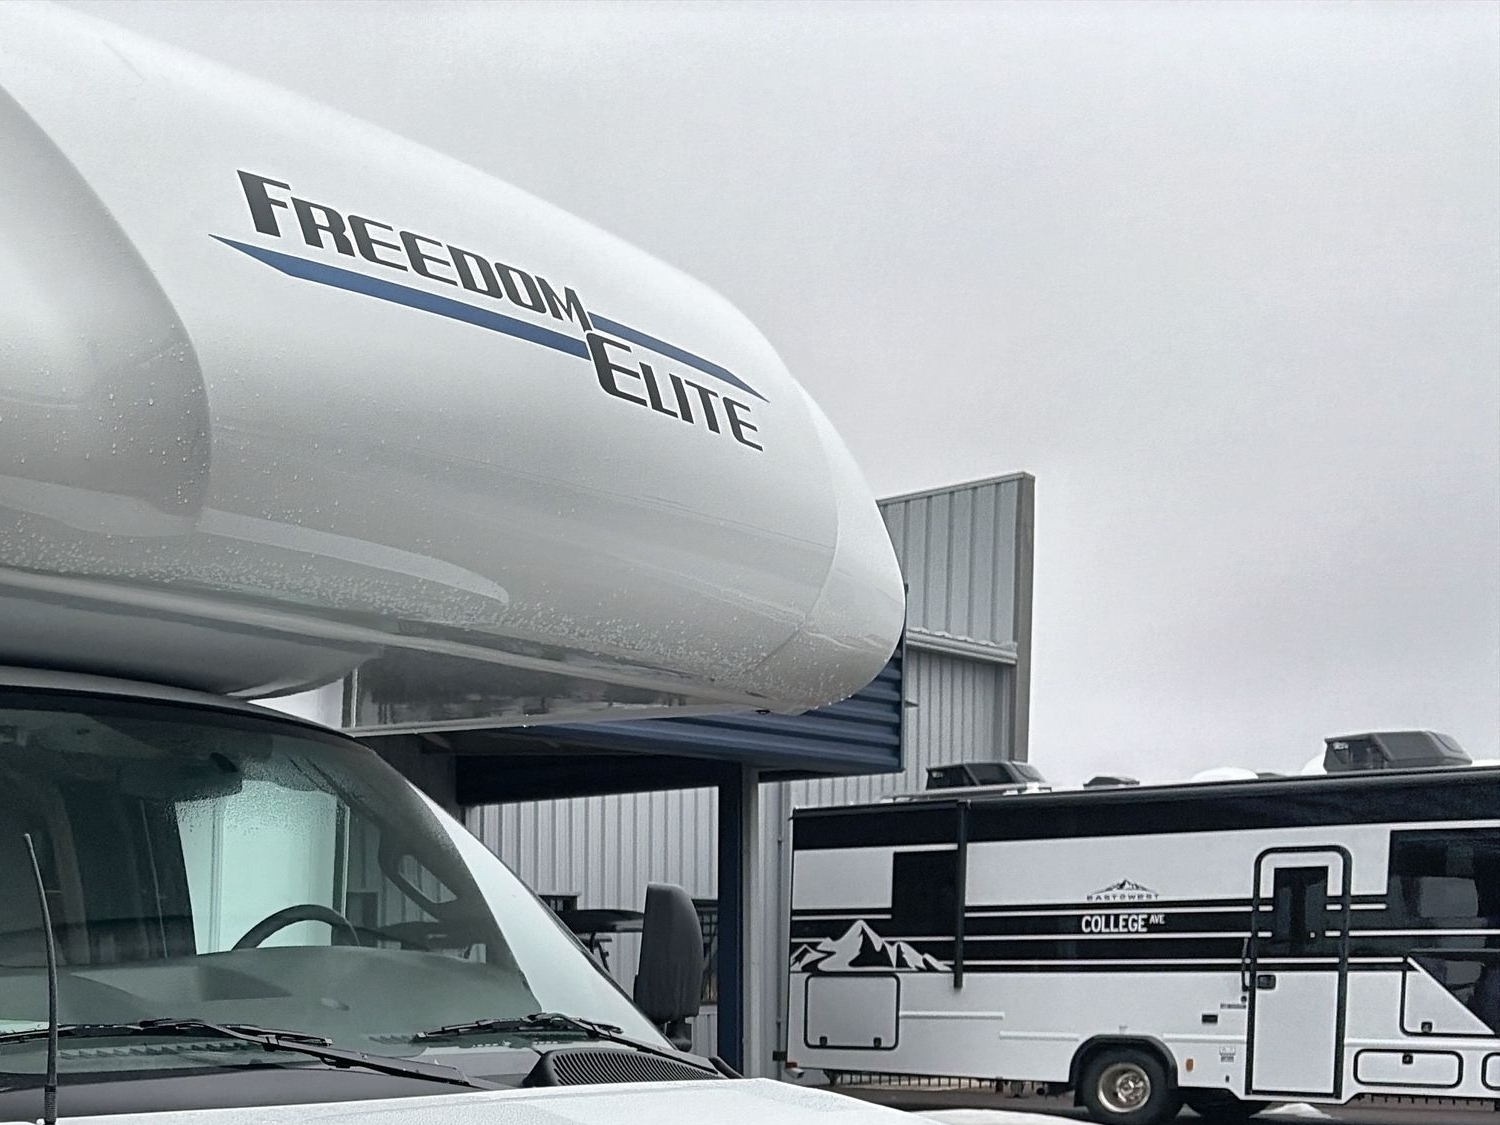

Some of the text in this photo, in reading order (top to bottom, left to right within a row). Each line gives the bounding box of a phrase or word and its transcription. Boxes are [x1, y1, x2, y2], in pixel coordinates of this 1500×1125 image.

[236, 169, 592, 331] FREEDOM
[586, 332, 764, 452] ELITE
[1081, 914, 1165, 933] COLLEGE AVE
